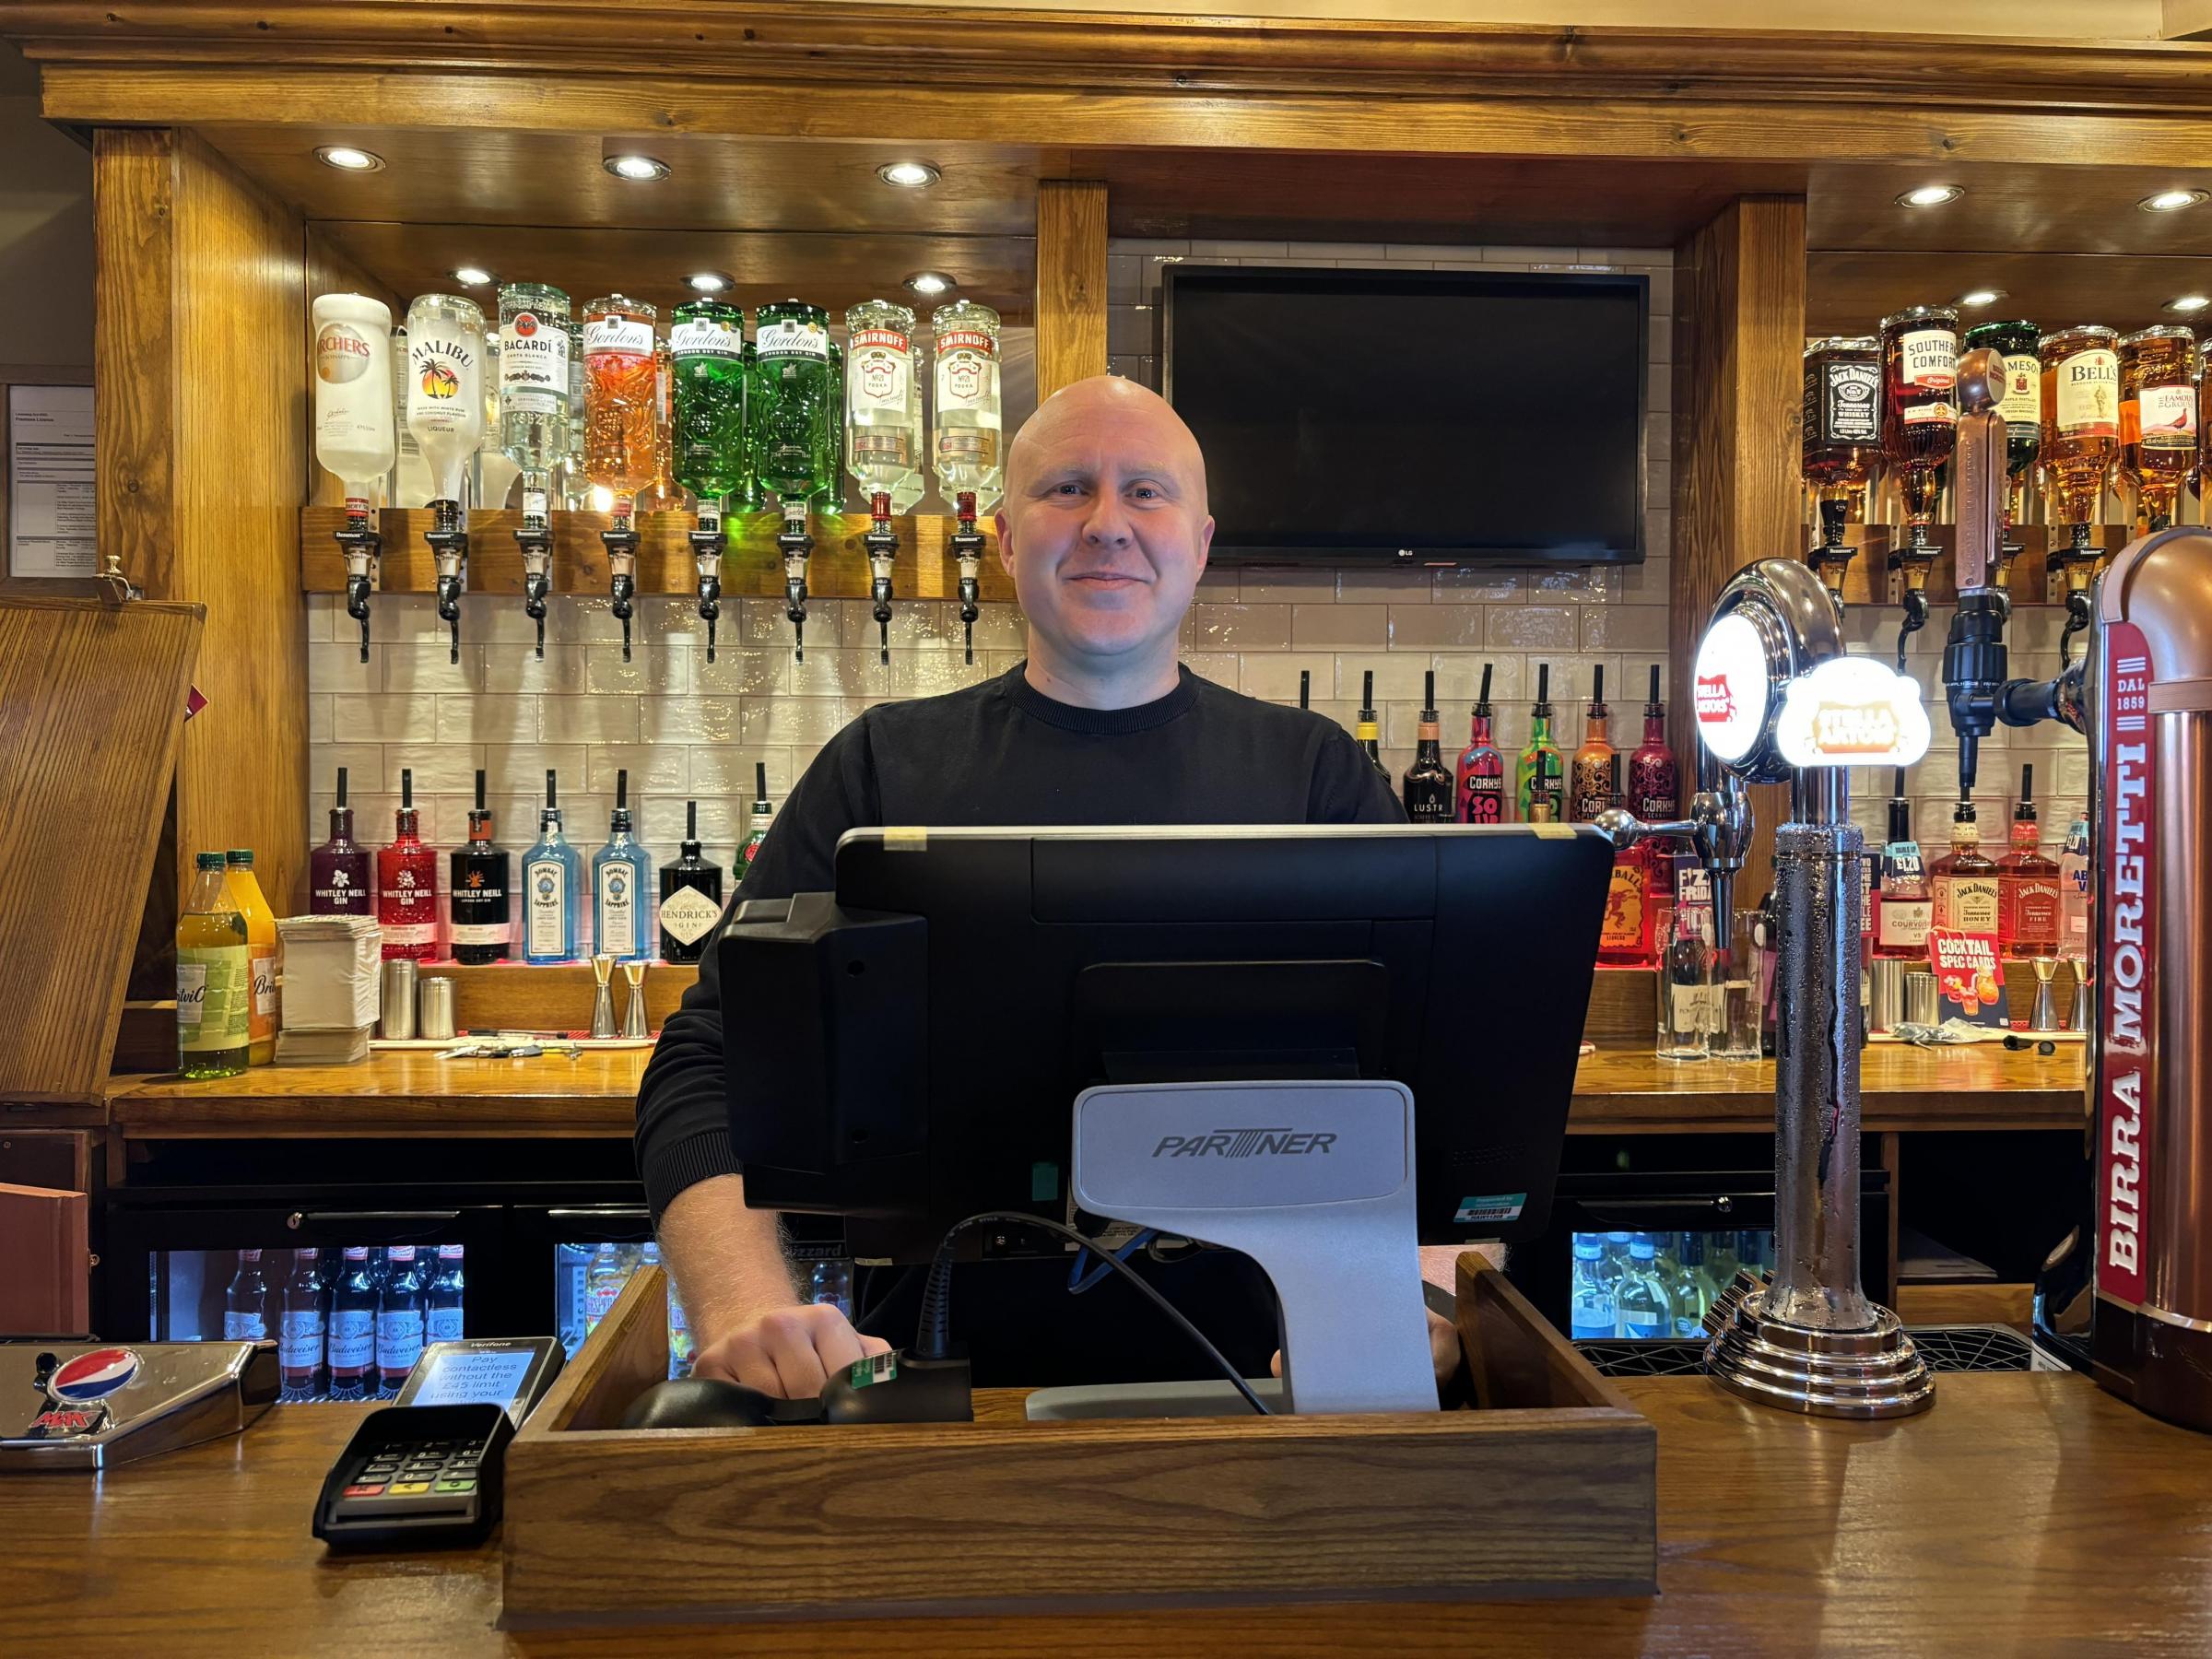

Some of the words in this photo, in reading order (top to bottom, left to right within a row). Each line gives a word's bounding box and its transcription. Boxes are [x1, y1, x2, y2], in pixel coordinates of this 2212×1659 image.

[586, 324, 643, 346] Gordon's
[675, 327, 731, 347] Gordon's
[762, 328, 818, 348] Gordon's
[853, 333, 904, 348] SMIRNOFF
[940, 334, 989, 348] SMIRNOFF
[318, 335, 371, 358] RCHERS
[504, 339, 552, 352] BACARDÍ
[412, 340, 474, 368] MALIBU
[1830, 371, 1849, 387] JACK
[2071, 366, 2117, 382] BELL'S
[2117, 678, 2145, 692] DAL
[2117, 696, 2145, 711] 1859
[1531, 777, 1562, 790] CRKYS
[1414, 804, 1444, 812] LUSTR
[1896, 857, 1920, 872] £1.20
[535, 867, 558, 877] BOMBAY
[606, 867, 629, 877] BOMBAY
[383, 890, 412, 899] WHITLEY
[415, 889, 432, 898] NEILL
[453, 889, 483, 898] WHITLEY
[485, 889, 502, 898] NEILL
[1957, 885, 1973, 899] JACK
[2018, 885, 2035, 899] JACK
[2035, 883, 2058, 900] DANIEL'S
[2113, 743, 2146, 1042] MORETTI
[400, 898, 414, 906] GIN
[534, 898, 559, 908] SAPPHIRE
[605, 898, 629, 908] SAPPHIRE
[661, 910, 718, 919] HENDRICK'S
[1937, 938, 1994, 957] COCKTAIL
[1939, 955, 1966, 968] SPEC
[1966, 956, 1996, 970] CARDS
[2109, 1066, 2141, 1277] BIRRA
[329, 1342, 372, 1354] Budweiser
[442, 1364, 516, 1372] contactless
[430, 1391, 467, 1400] using
[473, 1390, 503, 1398] your
[29, 1411, 102, 1429] MAX
